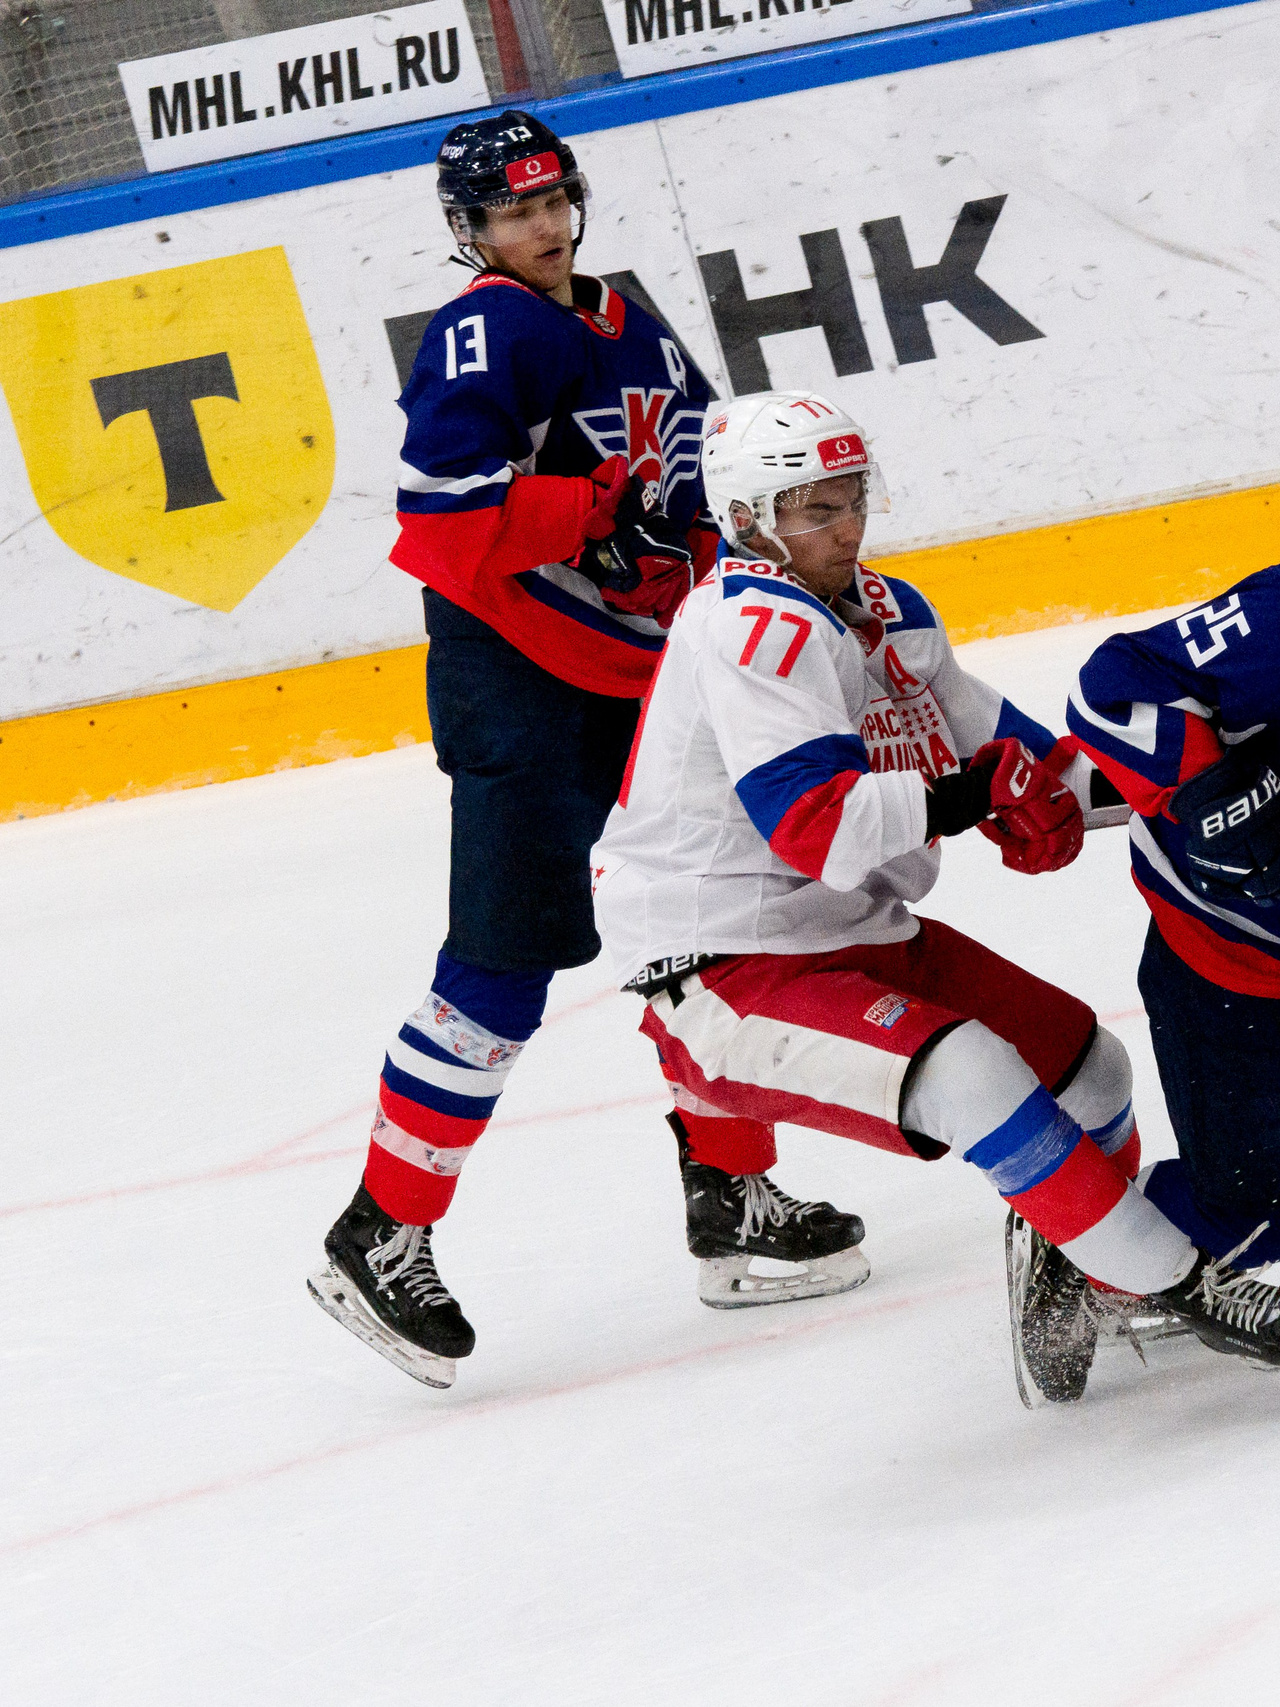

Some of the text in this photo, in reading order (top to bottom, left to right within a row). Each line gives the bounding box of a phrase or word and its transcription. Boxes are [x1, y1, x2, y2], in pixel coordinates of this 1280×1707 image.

[148, 27, 460, 140] MHL.KHL.RU
[513, 170, 559, 190] OLIMPBET
[445, 314, 489, 380] 13
[789, 399, 834, 419] 77
[826, 453, 866, 469] OLIMPBET
[738, 605, 813, 678] 77
[1176, 593, 1251, 669] 25
